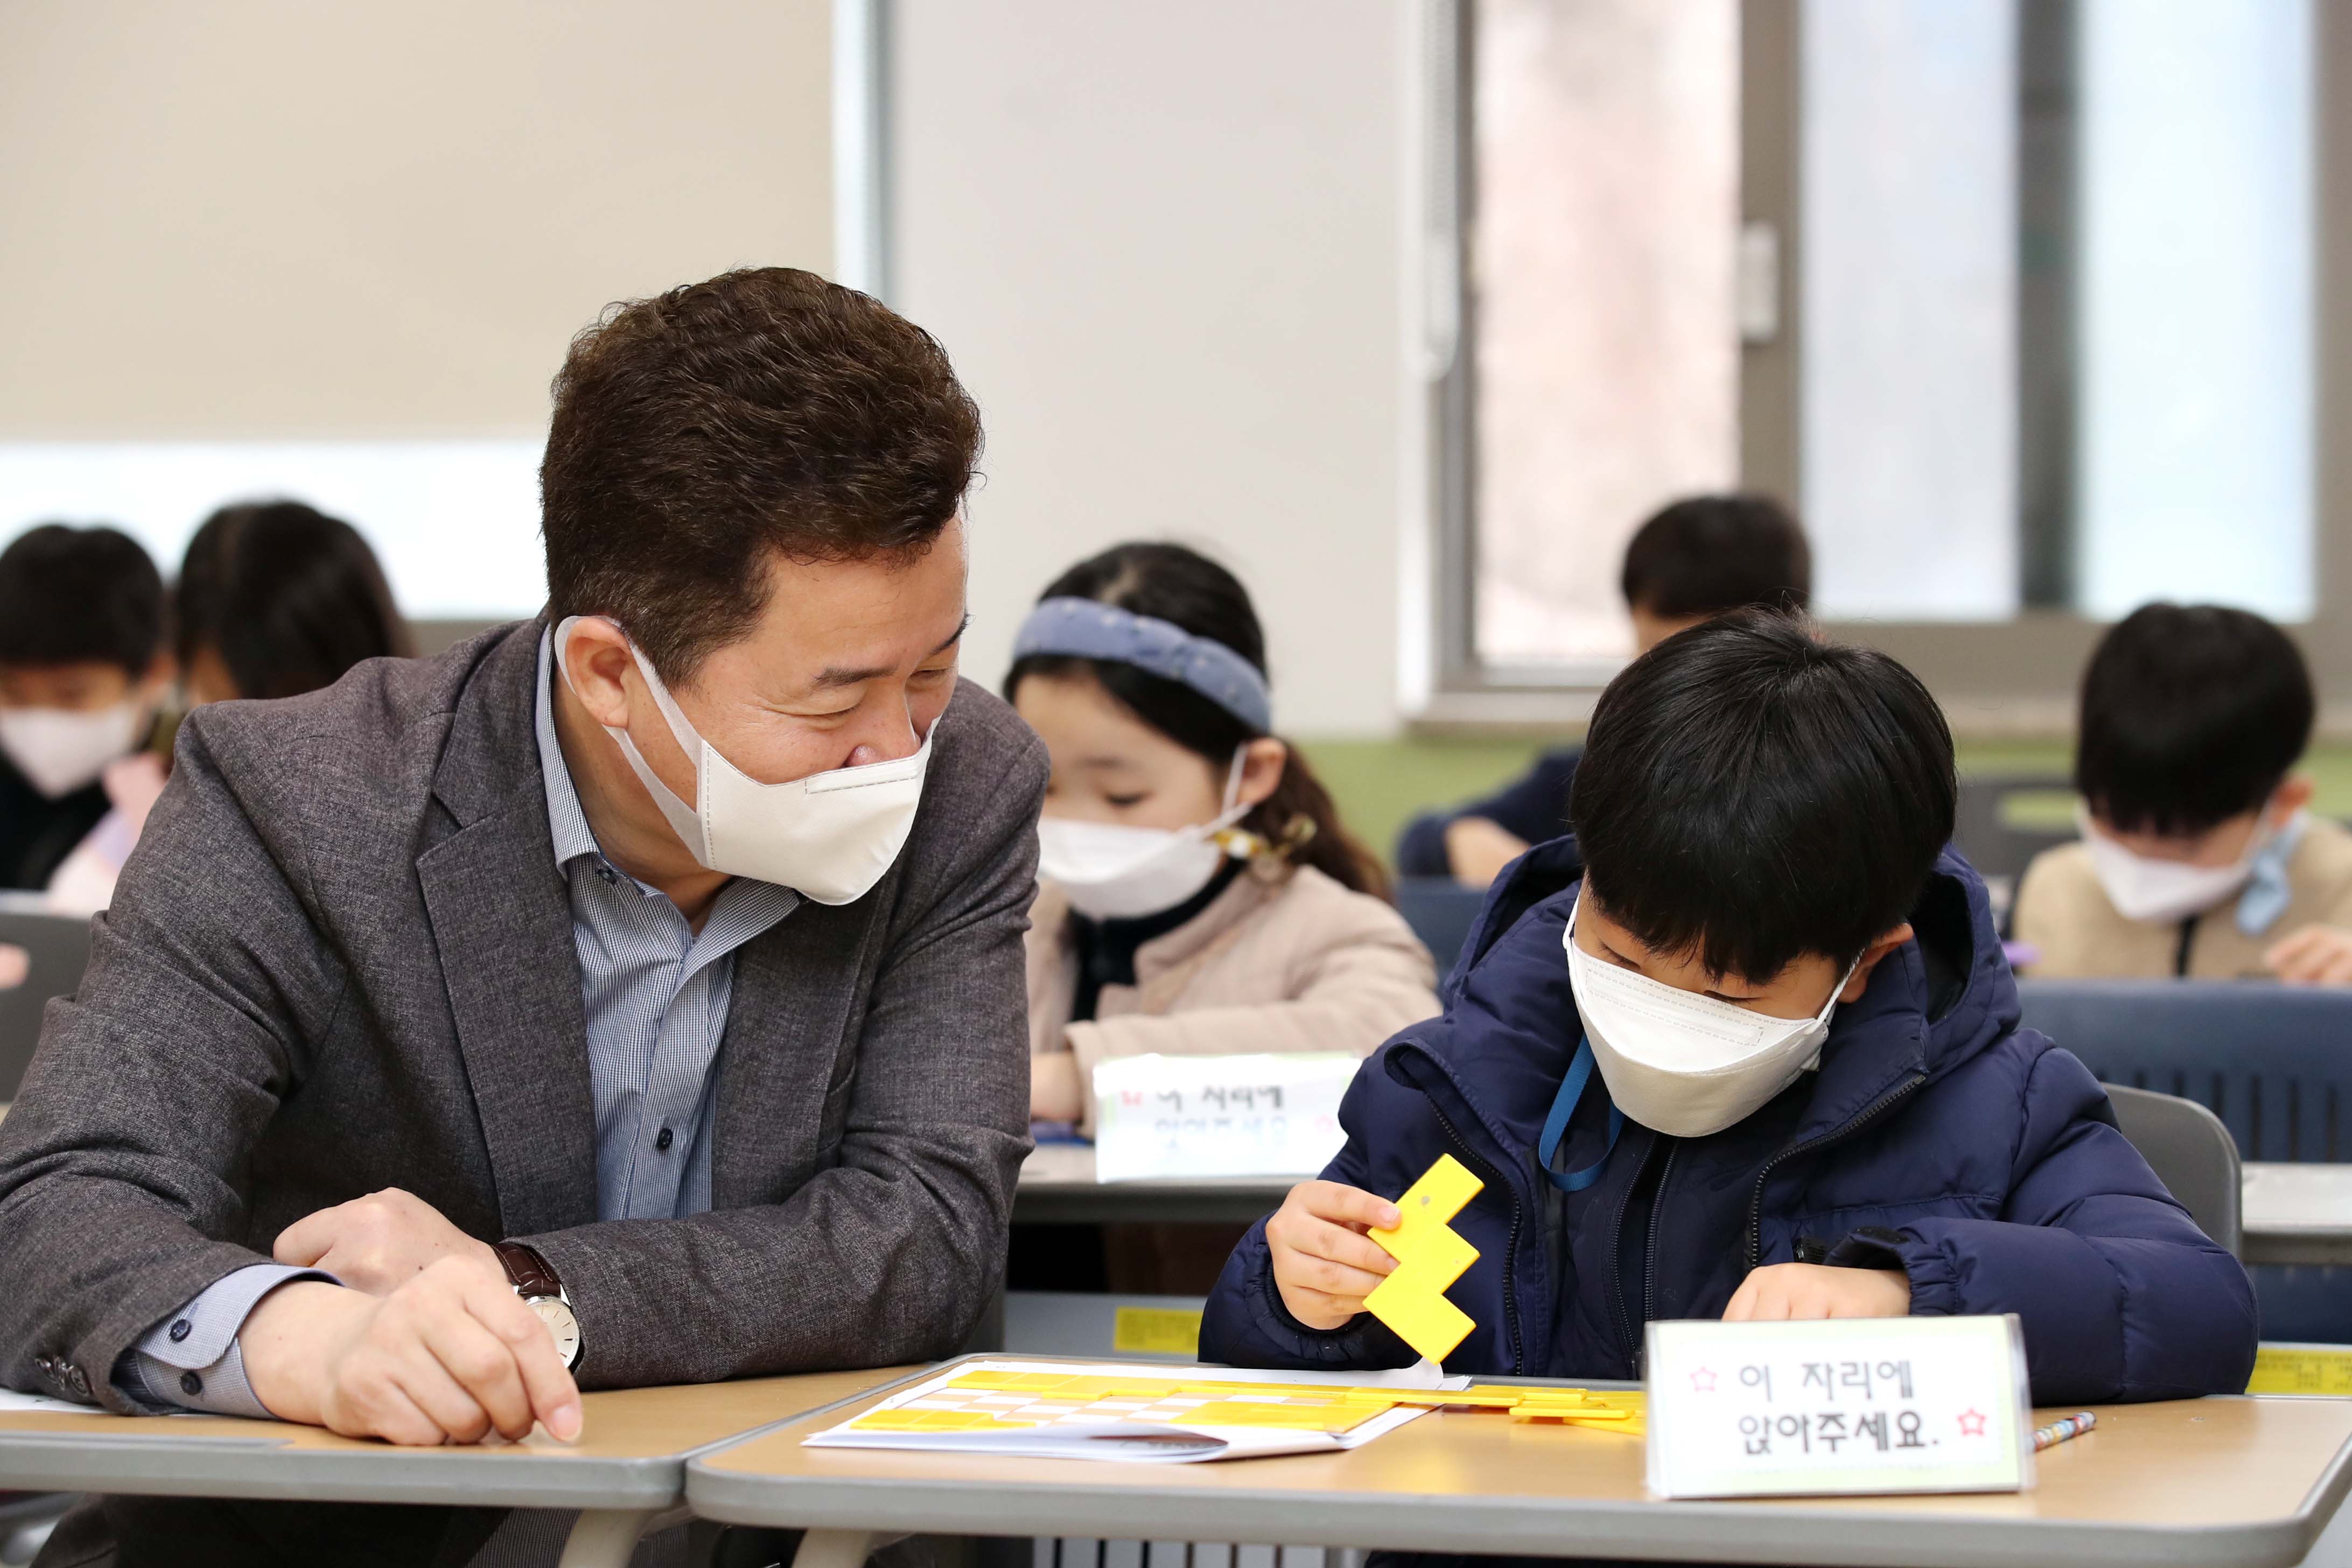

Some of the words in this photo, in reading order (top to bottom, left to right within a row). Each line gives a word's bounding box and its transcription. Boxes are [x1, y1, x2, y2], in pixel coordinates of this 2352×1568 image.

[1739, 1365, 1772, 1402] 이
[1802, 1360, 1914, 1400] 자리에
[1739, 1410, 1939, 1456] 앉아주세요.
